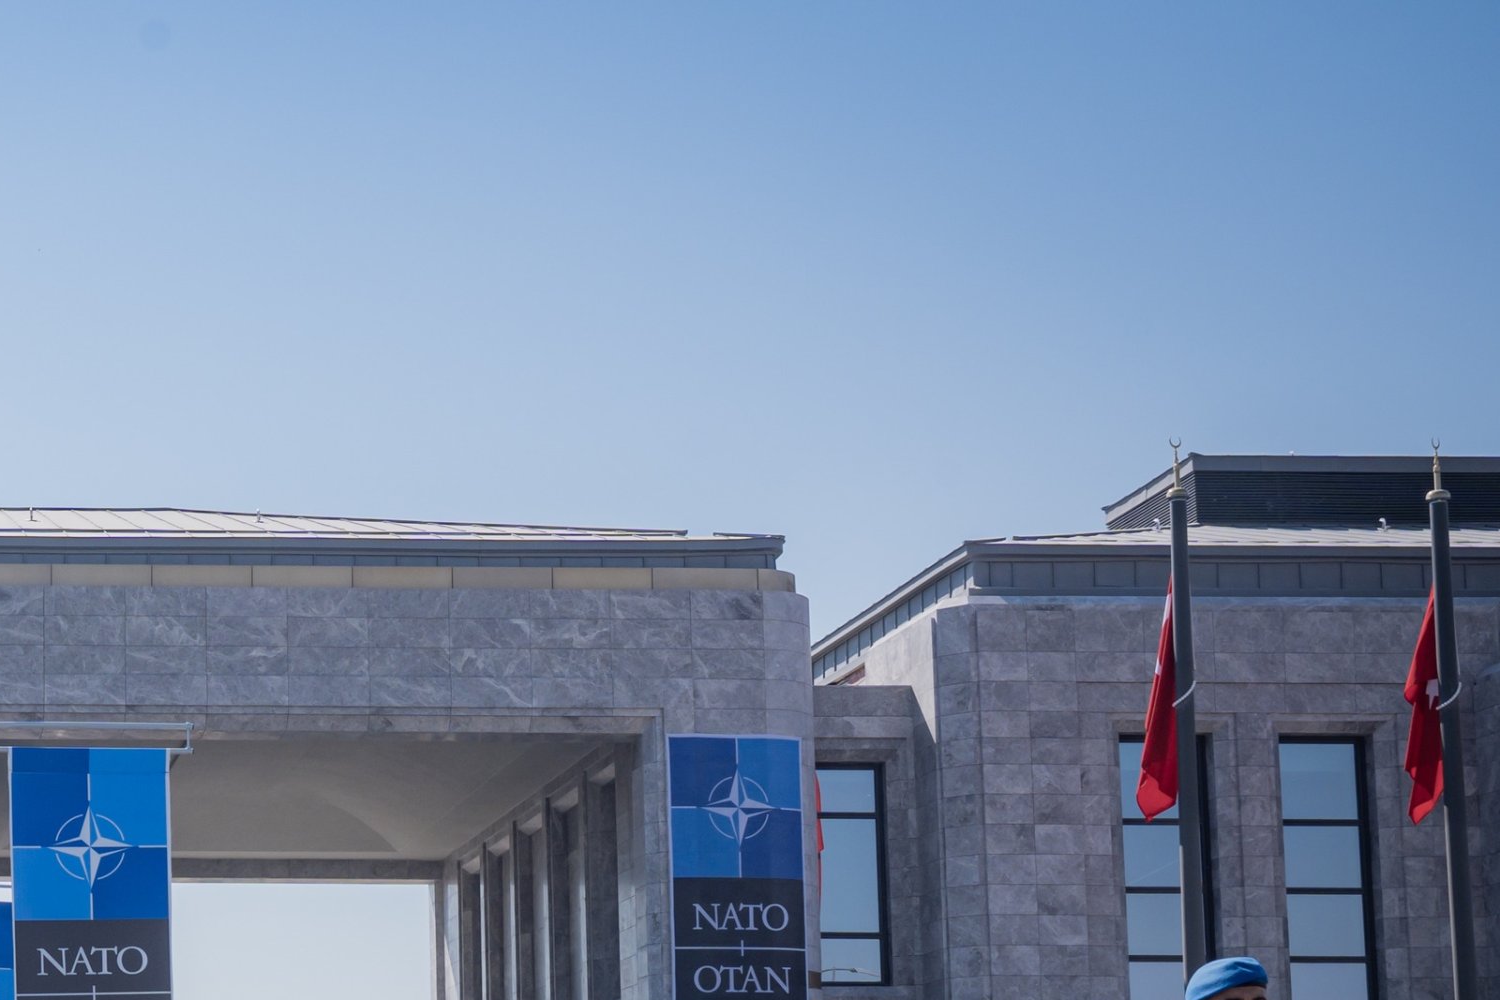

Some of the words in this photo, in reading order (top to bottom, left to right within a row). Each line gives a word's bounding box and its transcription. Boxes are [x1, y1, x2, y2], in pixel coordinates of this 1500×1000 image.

[692, 902, 789, 931] NATO
[36, 946, 148, 976] NATO
[693, 965, 791, 994] OTAN
